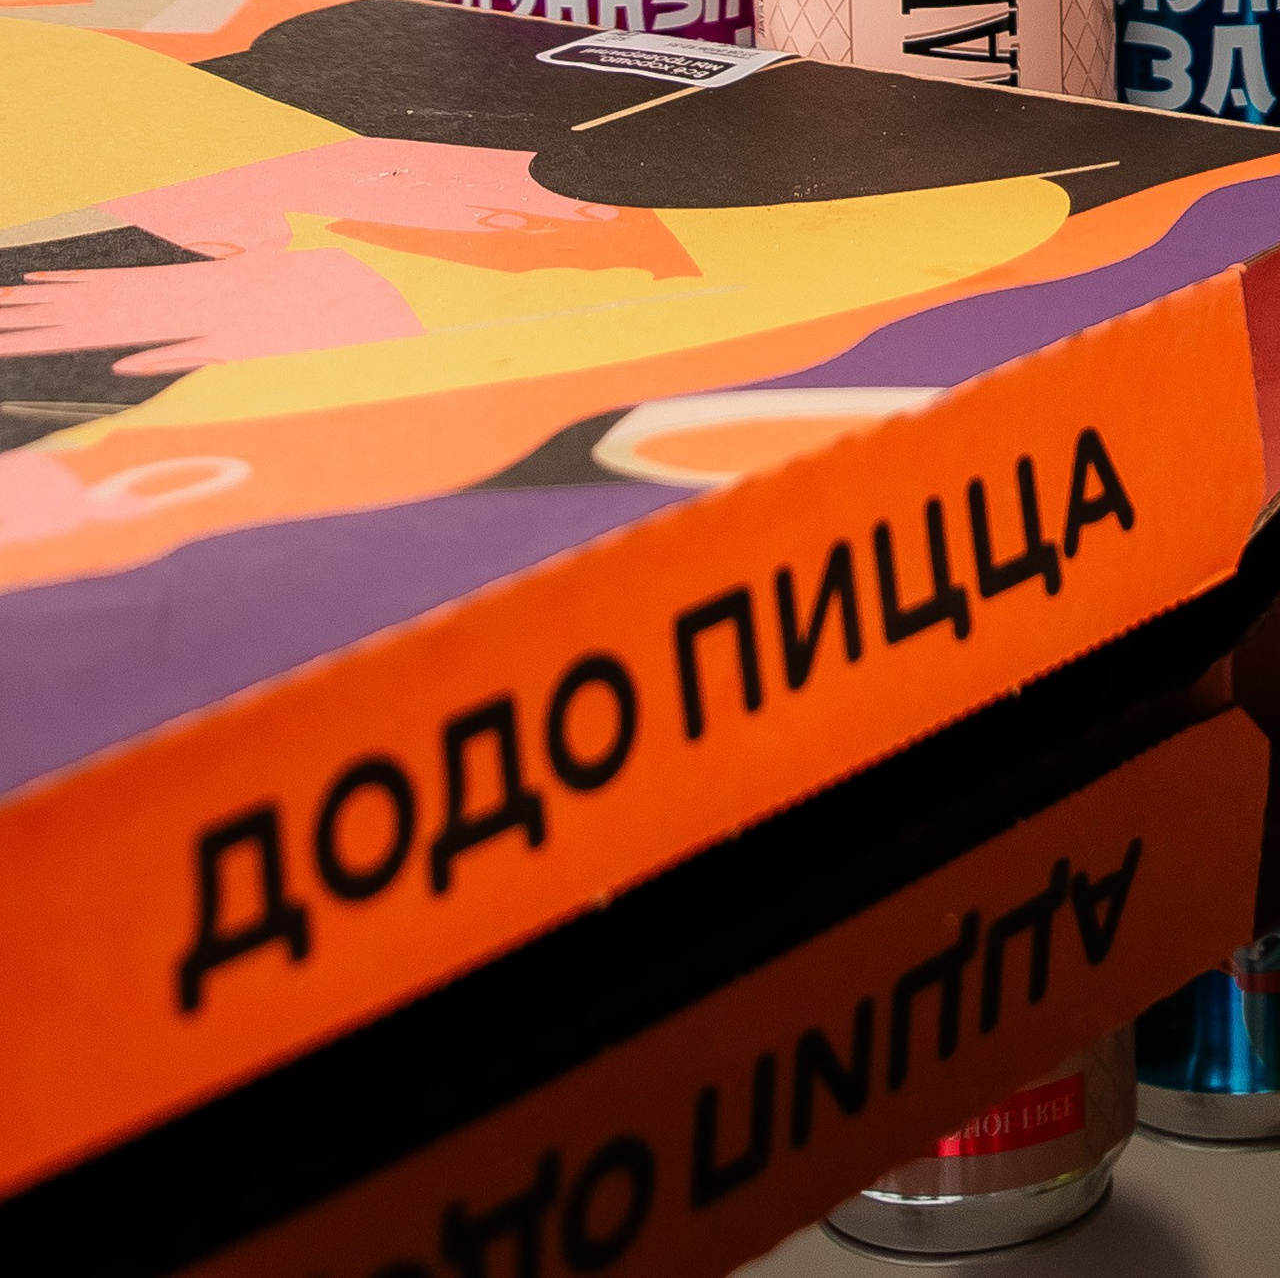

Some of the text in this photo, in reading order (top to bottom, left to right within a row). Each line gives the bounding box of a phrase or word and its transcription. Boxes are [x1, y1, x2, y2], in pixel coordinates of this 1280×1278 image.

[692, 59, 725, 72] Мы
[175, 425, 1135, 1015] ДОДО ПИЦЦА
